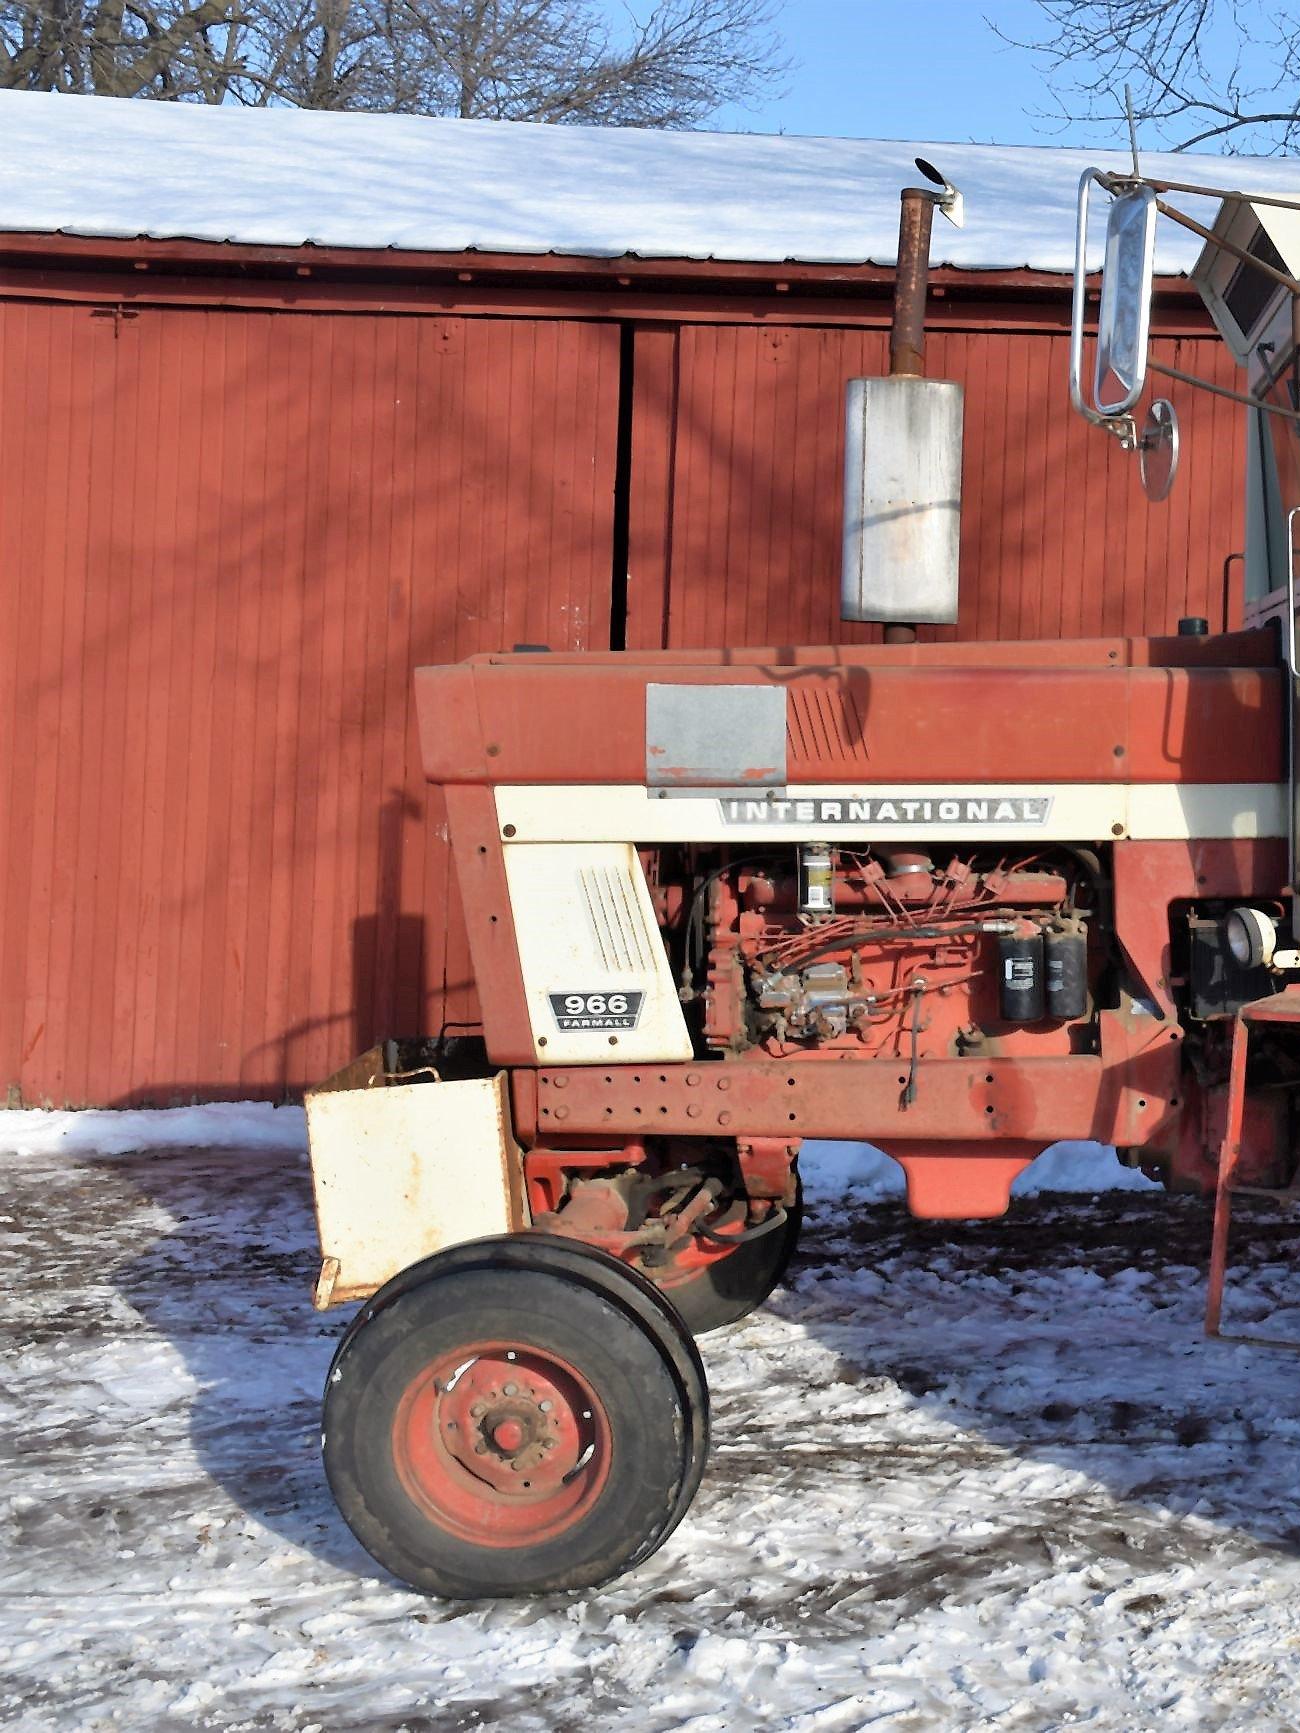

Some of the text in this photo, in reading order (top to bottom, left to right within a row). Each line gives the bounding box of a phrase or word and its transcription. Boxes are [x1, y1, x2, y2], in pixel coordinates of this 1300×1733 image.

[729, 800, 1041, 822] INTERNATIONAL
[564, 994, 628, 1015] 966
[562, 1018, 630, 1028] FARMALL
